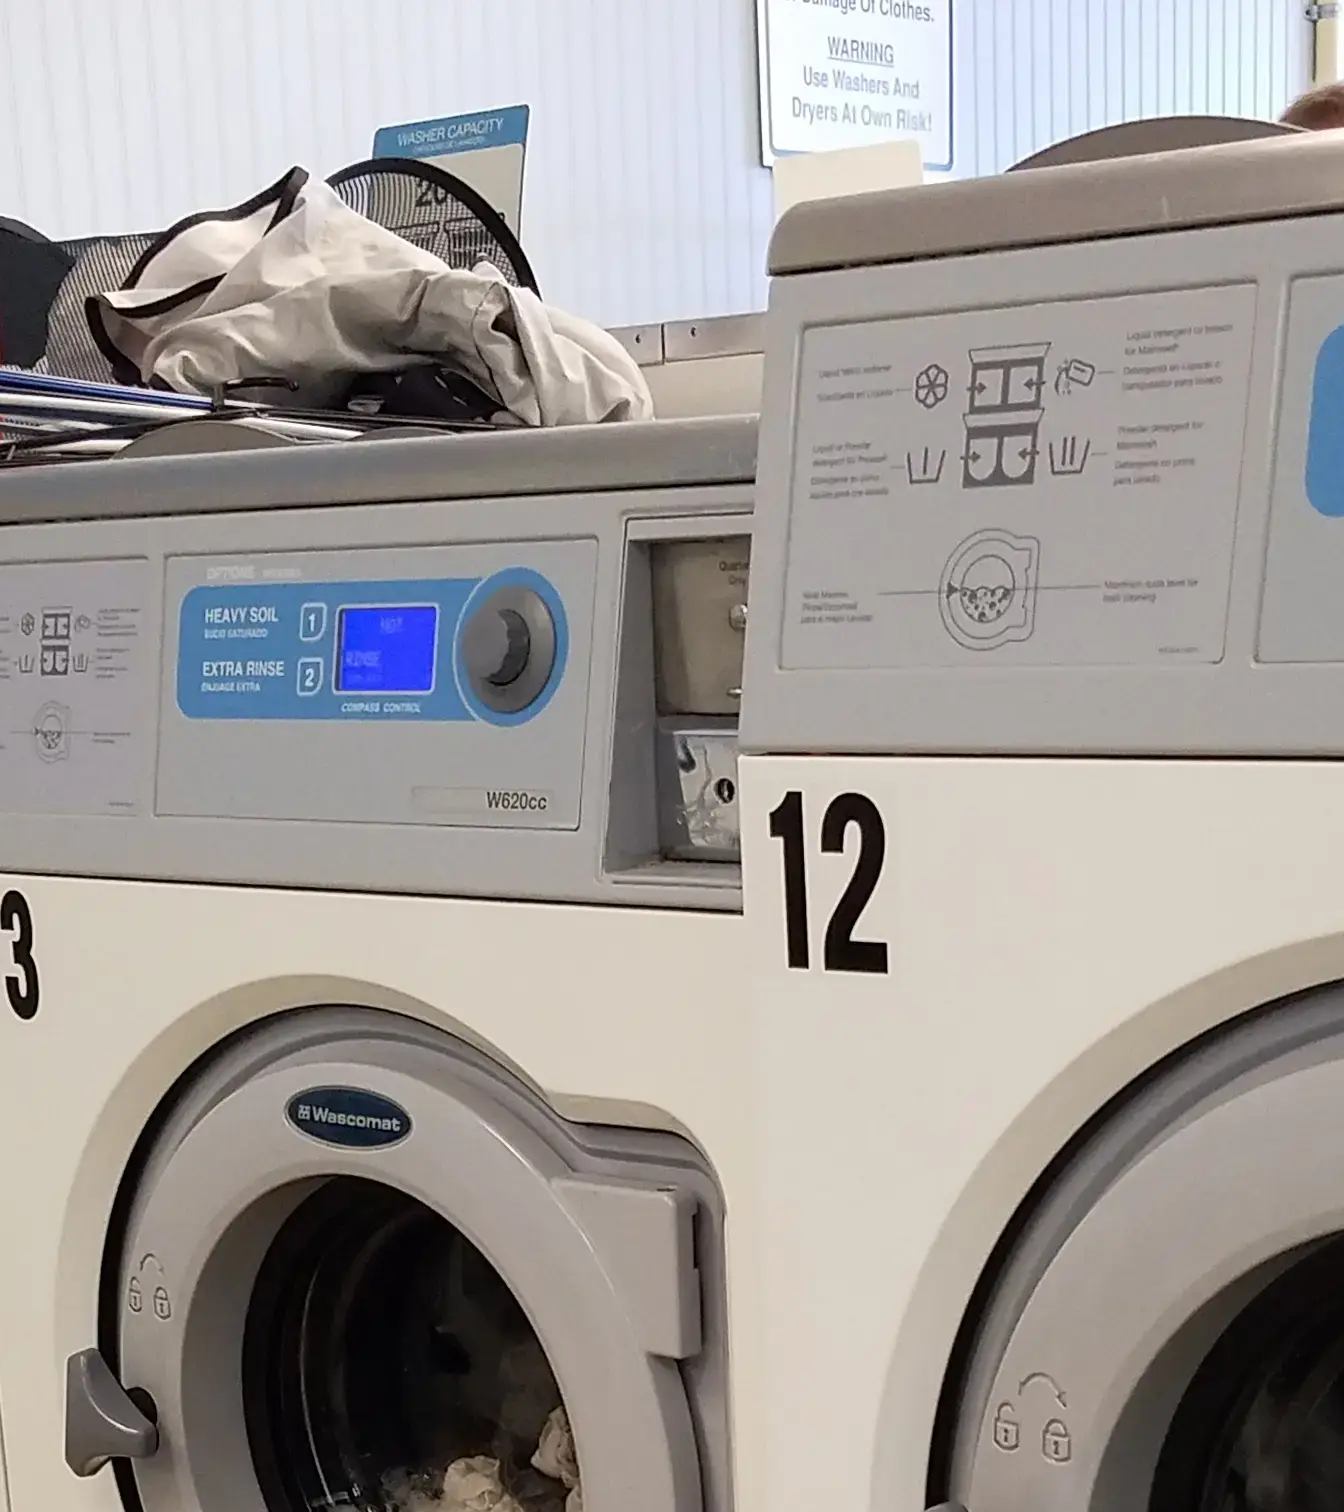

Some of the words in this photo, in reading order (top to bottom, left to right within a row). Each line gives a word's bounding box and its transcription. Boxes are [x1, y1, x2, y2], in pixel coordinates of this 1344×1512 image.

[880, 0, 935, 22] Clothes.
[827, 36, 894, 65] WARNING
[803, 65, 828, 88] Use
[832, 68, 889, 96] Washers
[893, 77, 919, 99] And
[792, 96, 837, 125] Dryers
[842, 102, 856, 124] At
[861, 104, 892, 128] Own
[896, 109, 932, 132] Risk!
[397, 127, 445, 147] WASHER
[447, 117, 504, 139] CAPACITY
[204, 607, 248, 623] HEAVY
[249, 606, 279, 622] SOIL
[308, 612, 316, 632] 1
[202, 661, 244, 677] EXTRA
[246, 660, 284, 676] RINSE
[305, 668, 315, 687] 2
[383, 702, 421, 713] CONTROL
[486, 791, 548, 810] W620cc
[769, 790, 889, 975] 12
[311, 1105, 401, 1132] Wascomat
